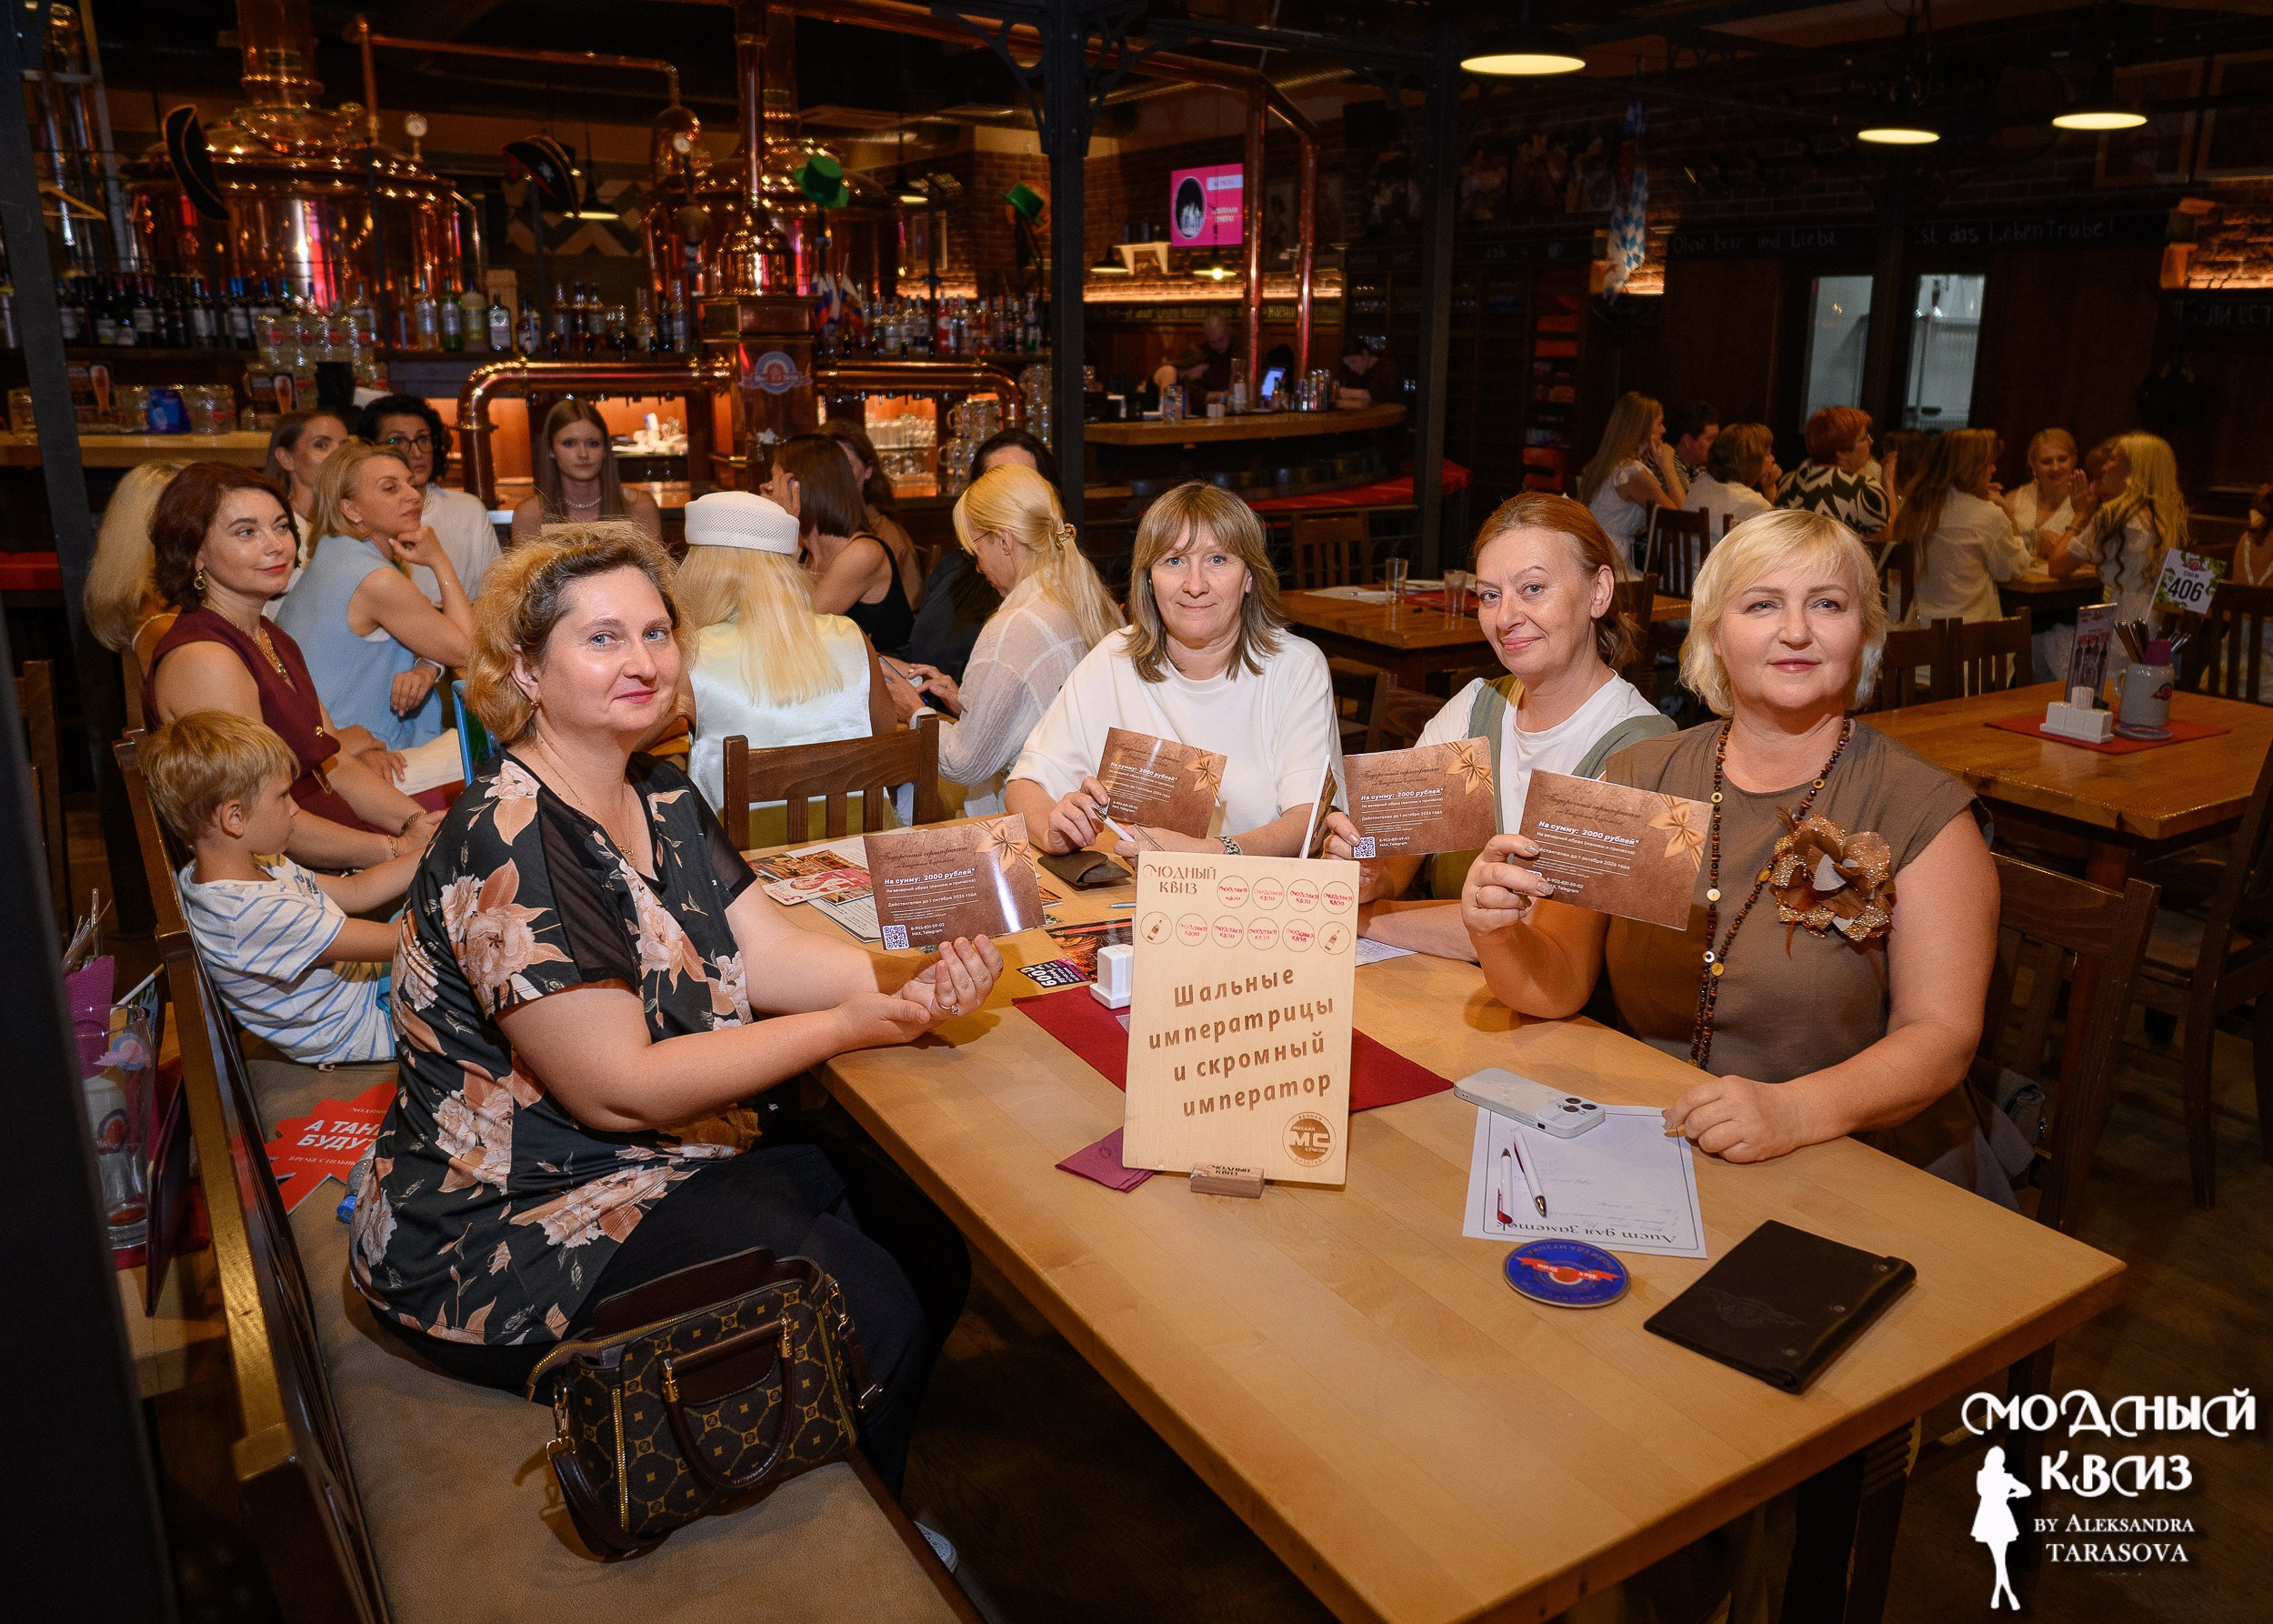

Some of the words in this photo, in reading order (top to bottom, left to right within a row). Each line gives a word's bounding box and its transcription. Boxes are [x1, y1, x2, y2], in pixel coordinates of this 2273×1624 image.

[2168, 577, 2204, 602] 406
[1537, 820, 1550, 828] На
[1549, 823, 1578, 836] сумму:
[1581, 828, 1604, 838] 2000
[895, 874, 921, 886] сумму:
[923, 872, 943, 881] 2000
[1160, 881, 1197, 895] КВИЗ
[1174, 969, 1294, 1007] Шальные
[1149, 998, 1333, 1049] императрицы
[1174, 1066, 1186, 1082] и
[1197, 1031, 1325, 1078] скромный
[1183, 1074, 1330, 1118] император
[304, 1119, 325, 1132] А
[296, 1133, 376, 1151] БУДУТ
